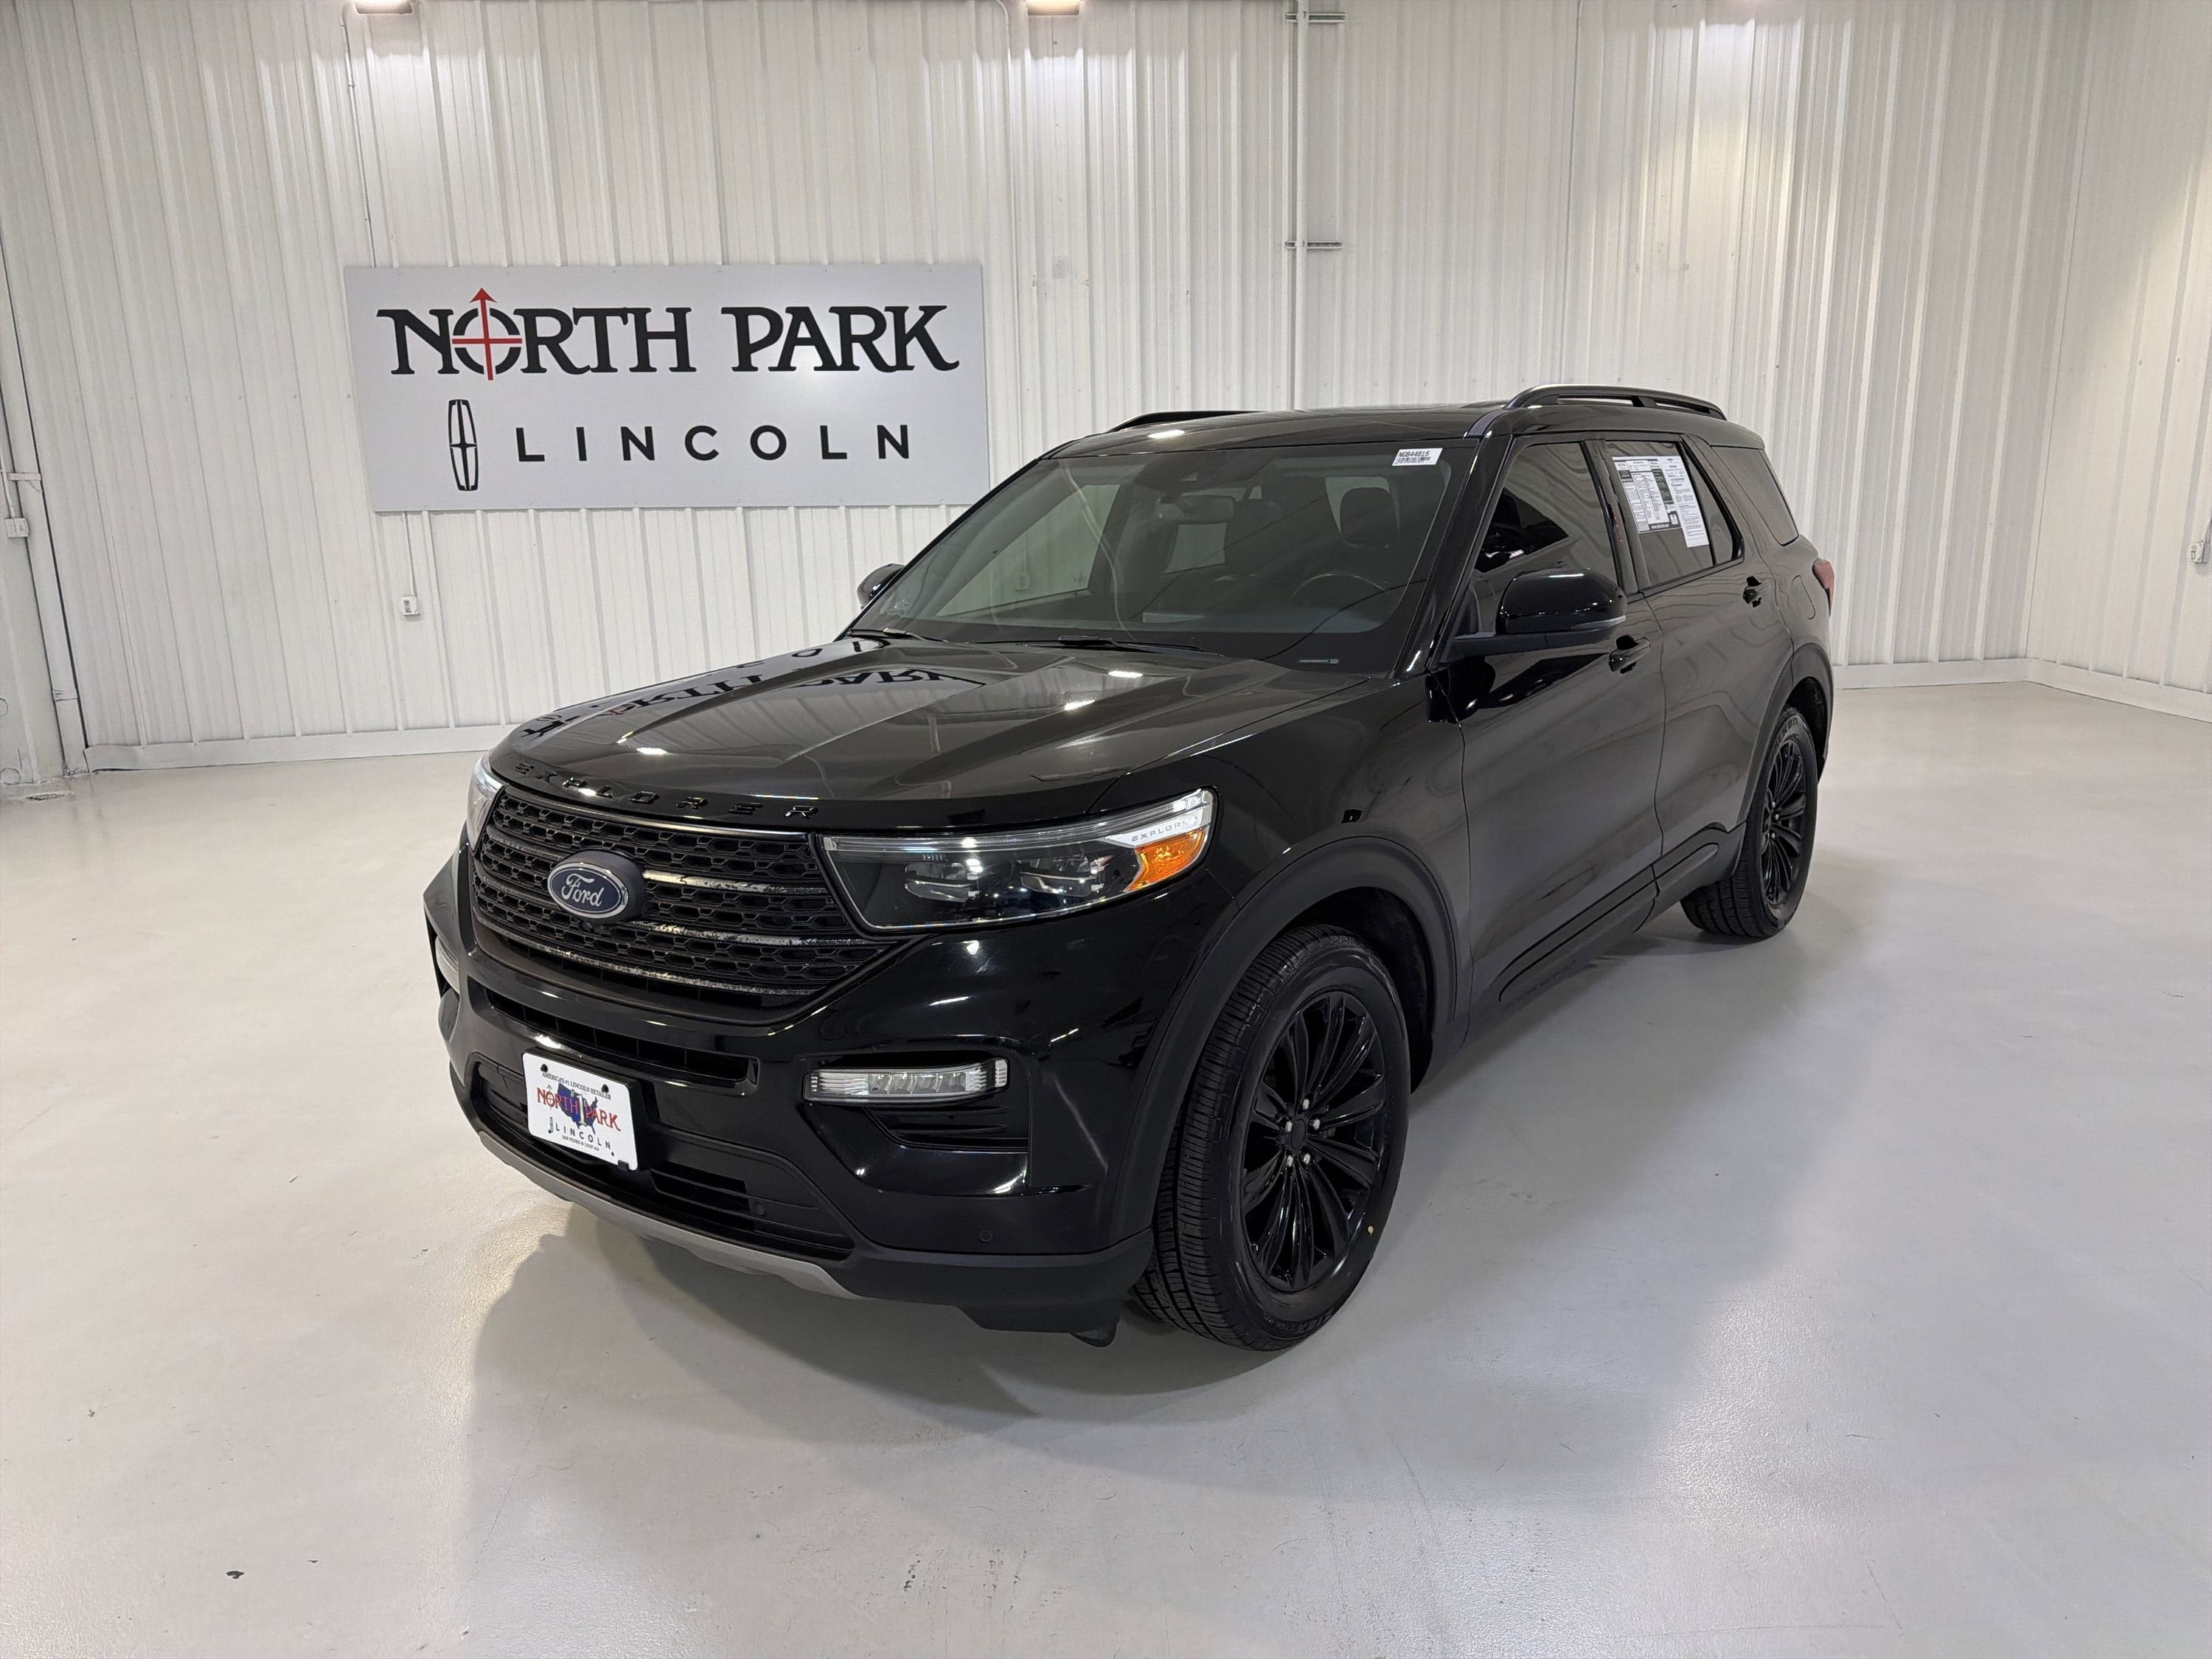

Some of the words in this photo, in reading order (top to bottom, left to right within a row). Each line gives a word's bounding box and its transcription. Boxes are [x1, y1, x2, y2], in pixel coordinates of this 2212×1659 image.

[376, 305, 696, 378] NORTH
[721, 305, 960, 372] PARK
[516, 424, 911, 462] LINCOLN
[561, 872, 605, 908] Ford
[570, 1081, 591, 1093] LINCOLN
[591, 1088, 612, 1100] RETAILER
[537, 1087, 580, 1115] NORTH
[585, 1105, 622, 1132] PARK
[555, 1122, 611, 1150] LINCOLN
